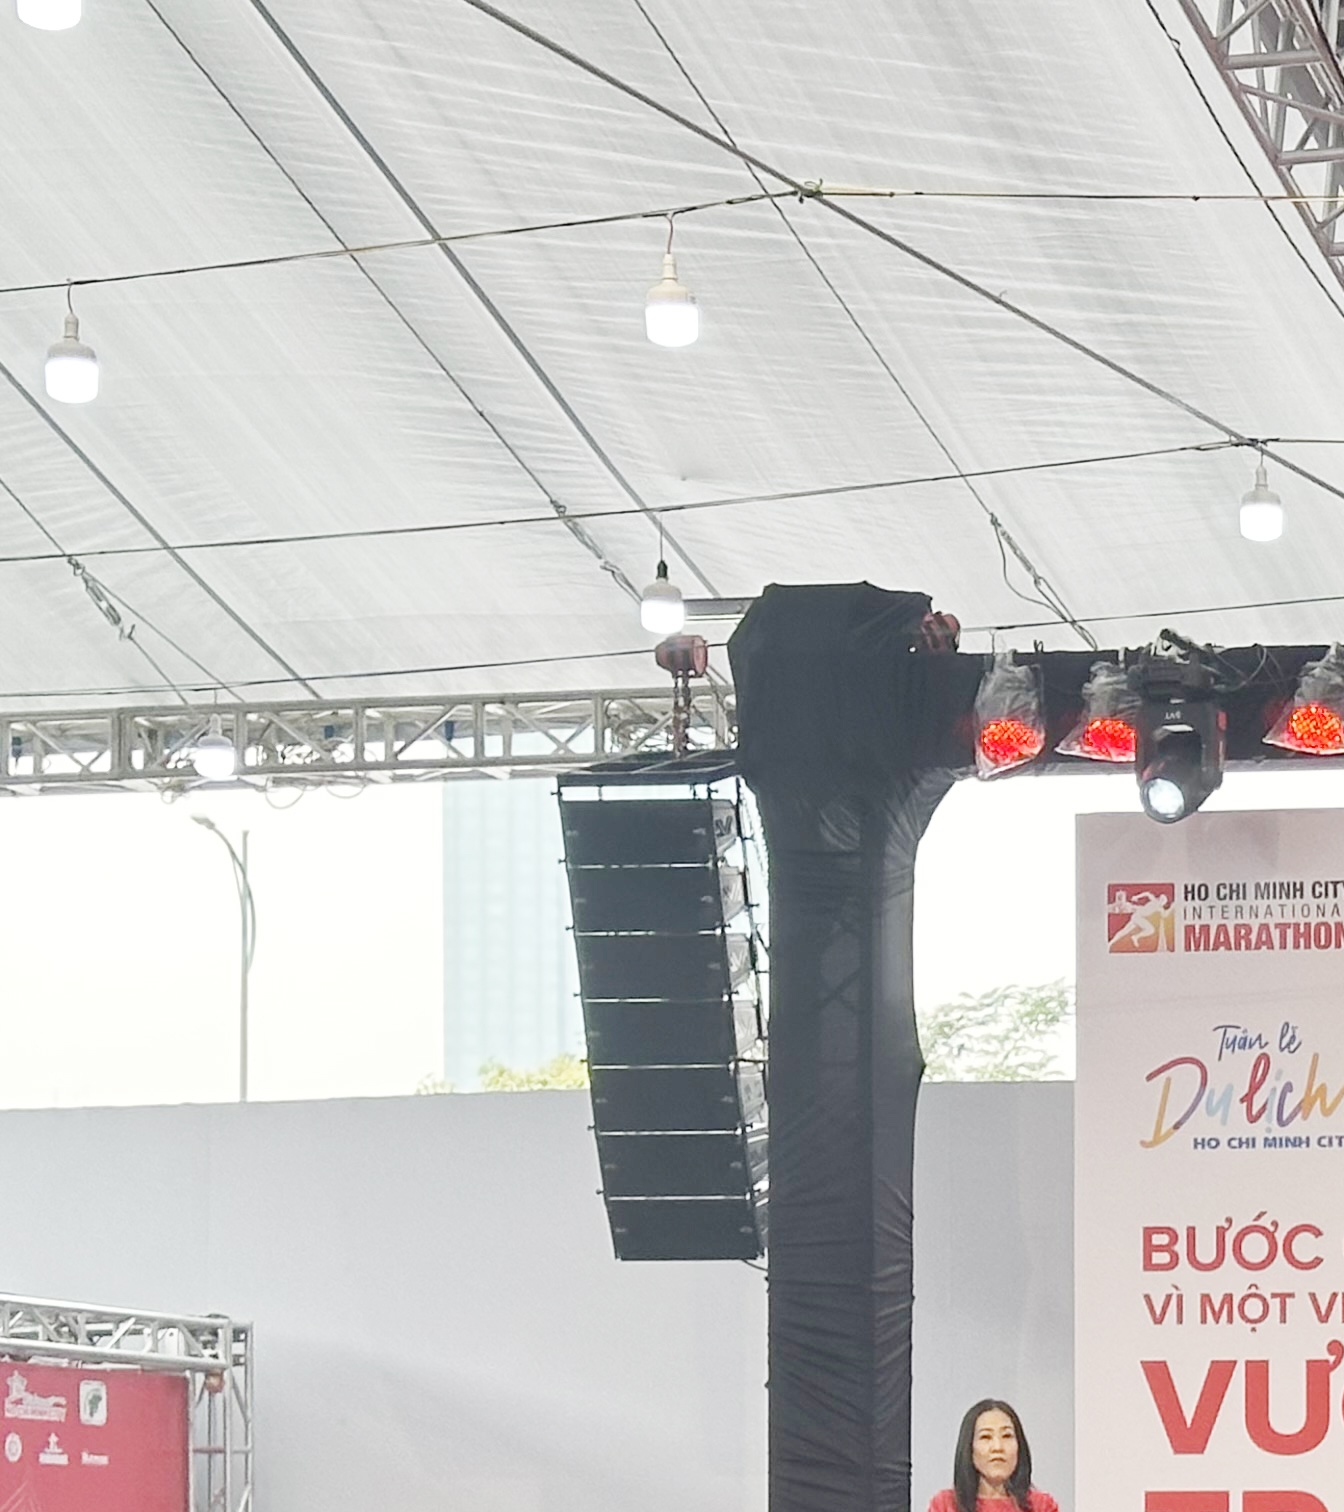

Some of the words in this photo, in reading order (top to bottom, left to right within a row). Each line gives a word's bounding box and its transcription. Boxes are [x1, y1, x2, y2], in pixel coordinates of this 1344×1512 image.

[1184, 883, 1209, 901] HO
[1216, 882, 1247, 901] CHI
[1254, 881, 1304, 900] MINH
[1193, 1137, 1221, 1150] HO
[1227, 1136, 1256, 1150] CHI
[1263, 1135, 1310, 1149] MINH
[1142, 1211, 1324, 1272] BƯỚC
[1143, 1285, 1184, 1325] VÌ
[1199, 1283, 1295, 1332] MỘT
